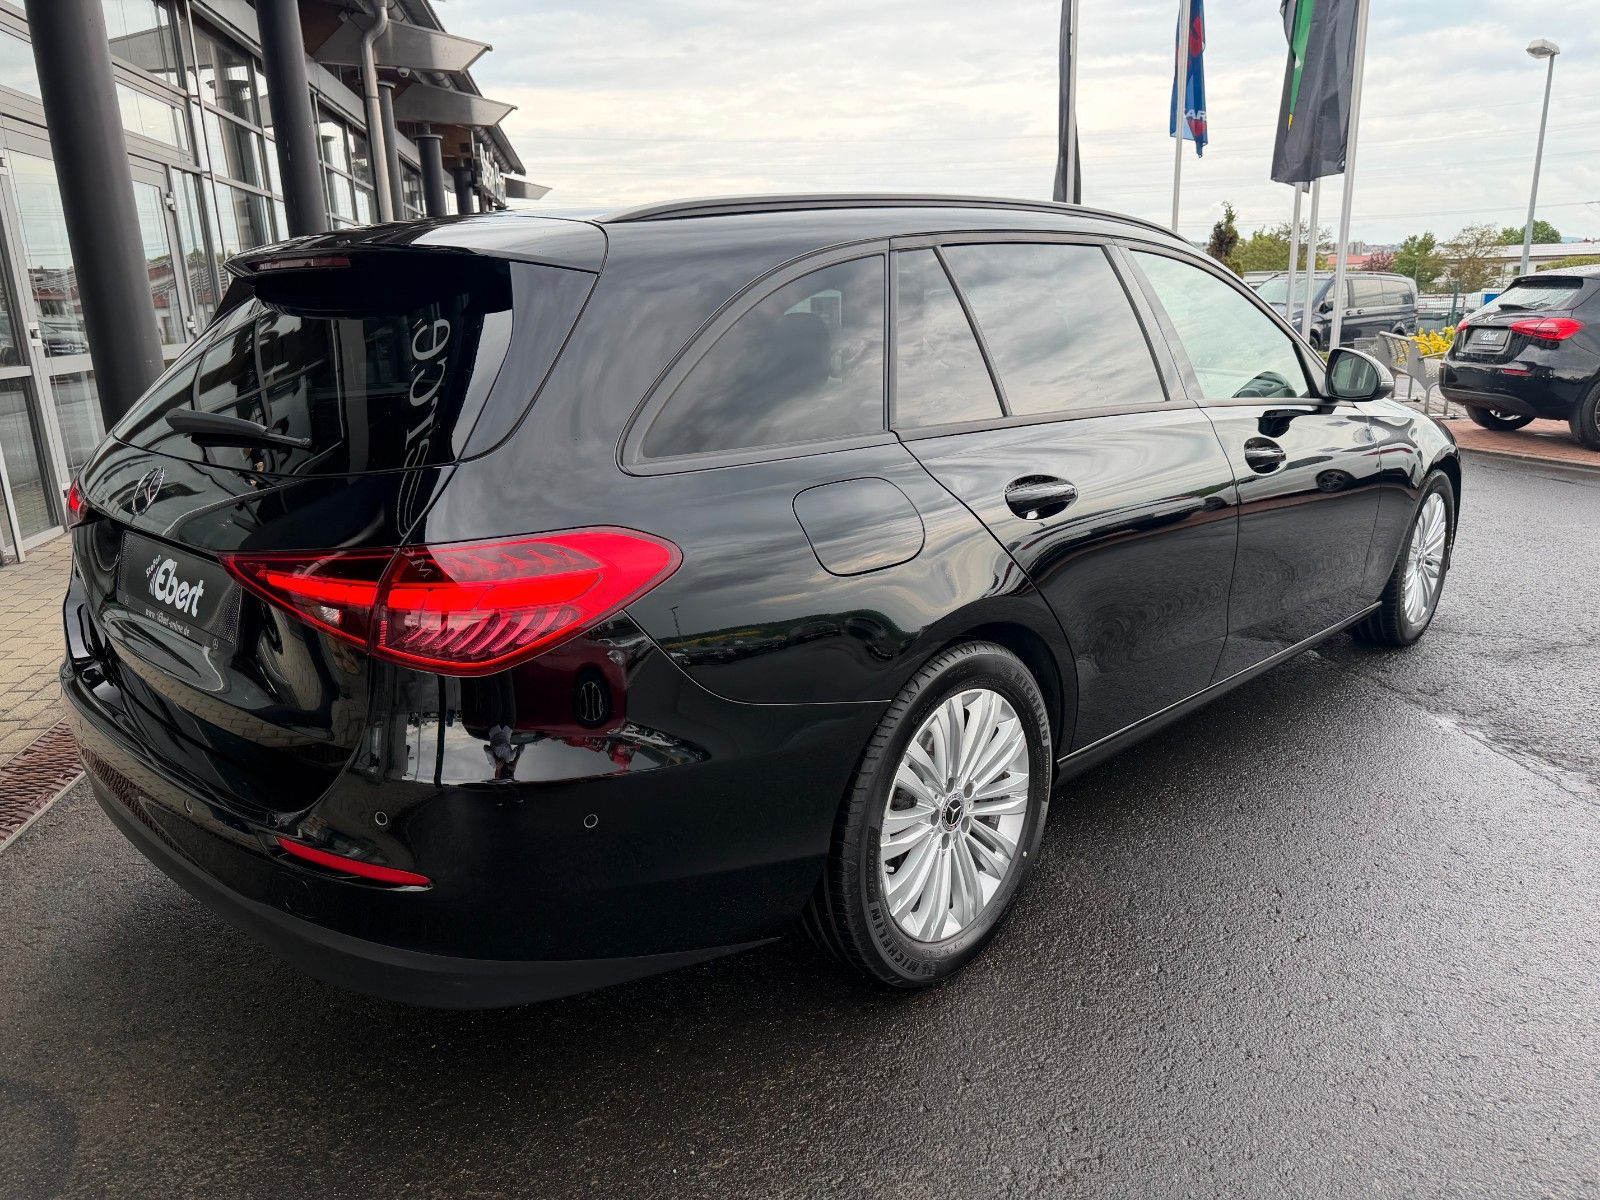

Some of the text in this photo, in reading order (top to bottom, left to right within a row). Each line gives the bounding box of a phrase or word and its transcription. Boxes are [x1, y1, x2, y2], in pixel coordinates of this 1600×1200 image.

[154, 559, 204, 617] Ebert
[1013, 672, 1049, 741] MICHELIN
[869, 905, 921, 975] MICHELIN
